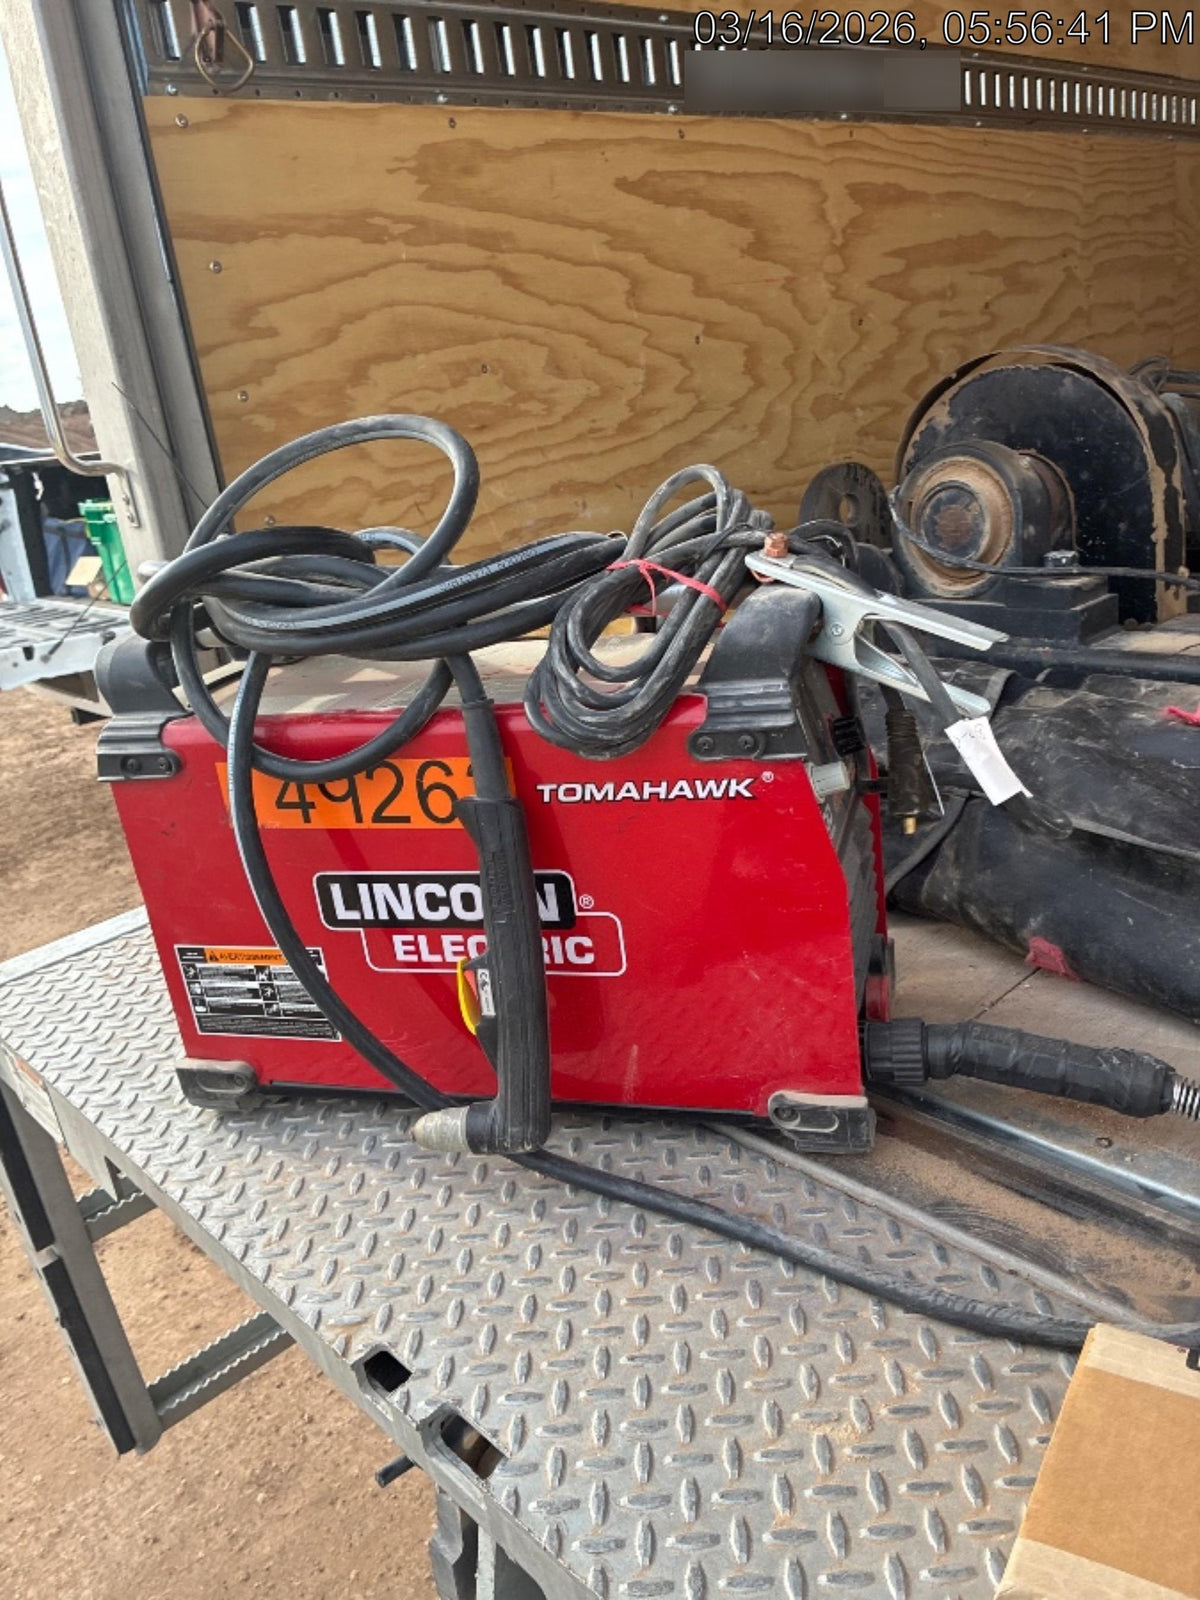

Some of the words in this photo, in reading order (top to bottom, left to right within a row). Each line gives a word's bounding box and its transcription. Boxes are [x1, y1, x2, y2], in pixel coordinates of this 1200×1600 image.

[275, 760, 473, 824] 4926
[536, 777, 755, 803] TOMAHAWK
[329, 882, 561, 922] LINCON
[392, 934, 595, 965] ELECIC
